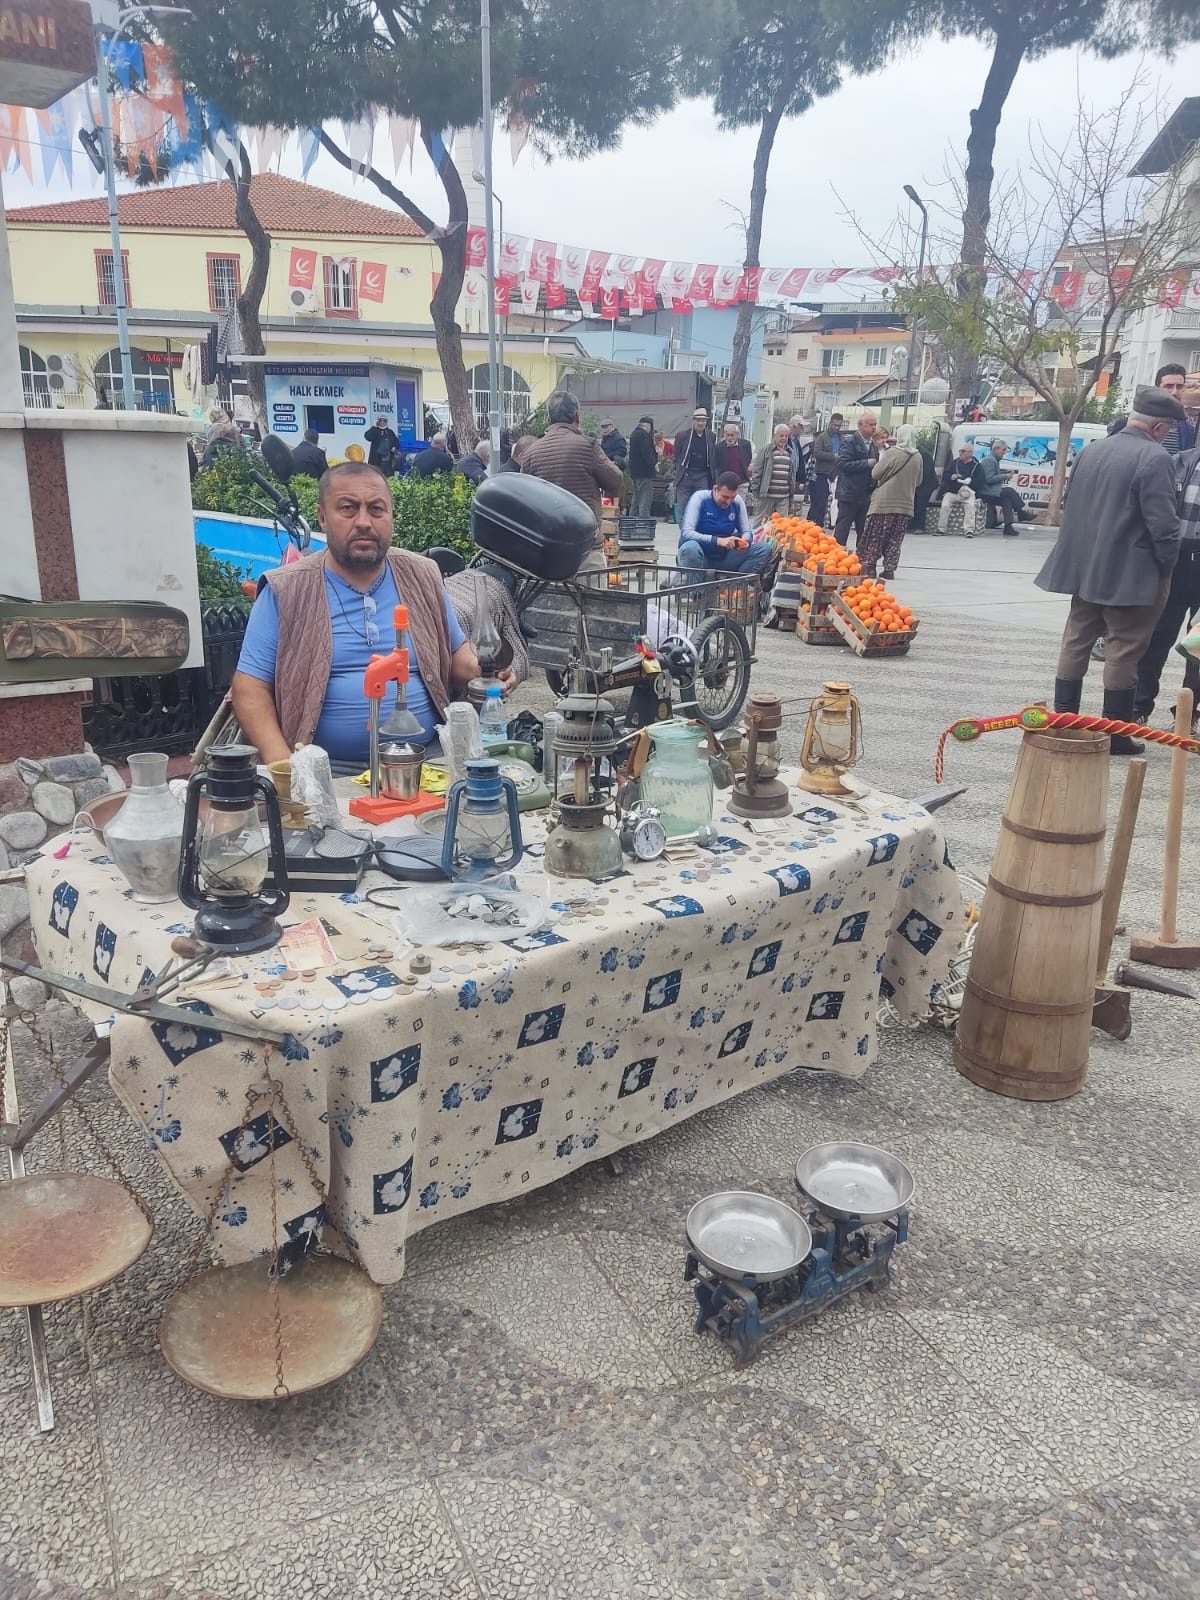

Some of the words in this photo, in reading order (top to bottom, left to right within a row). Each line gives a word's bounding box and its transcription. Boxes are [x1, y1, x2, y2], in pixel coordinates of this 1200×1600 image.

[289, 385, 312, 397] HALK
[314, 385, 344, 397] EKMEK
[375, 387, 390, 399] Halk
[373, 401, 394, 414] Ekmek
